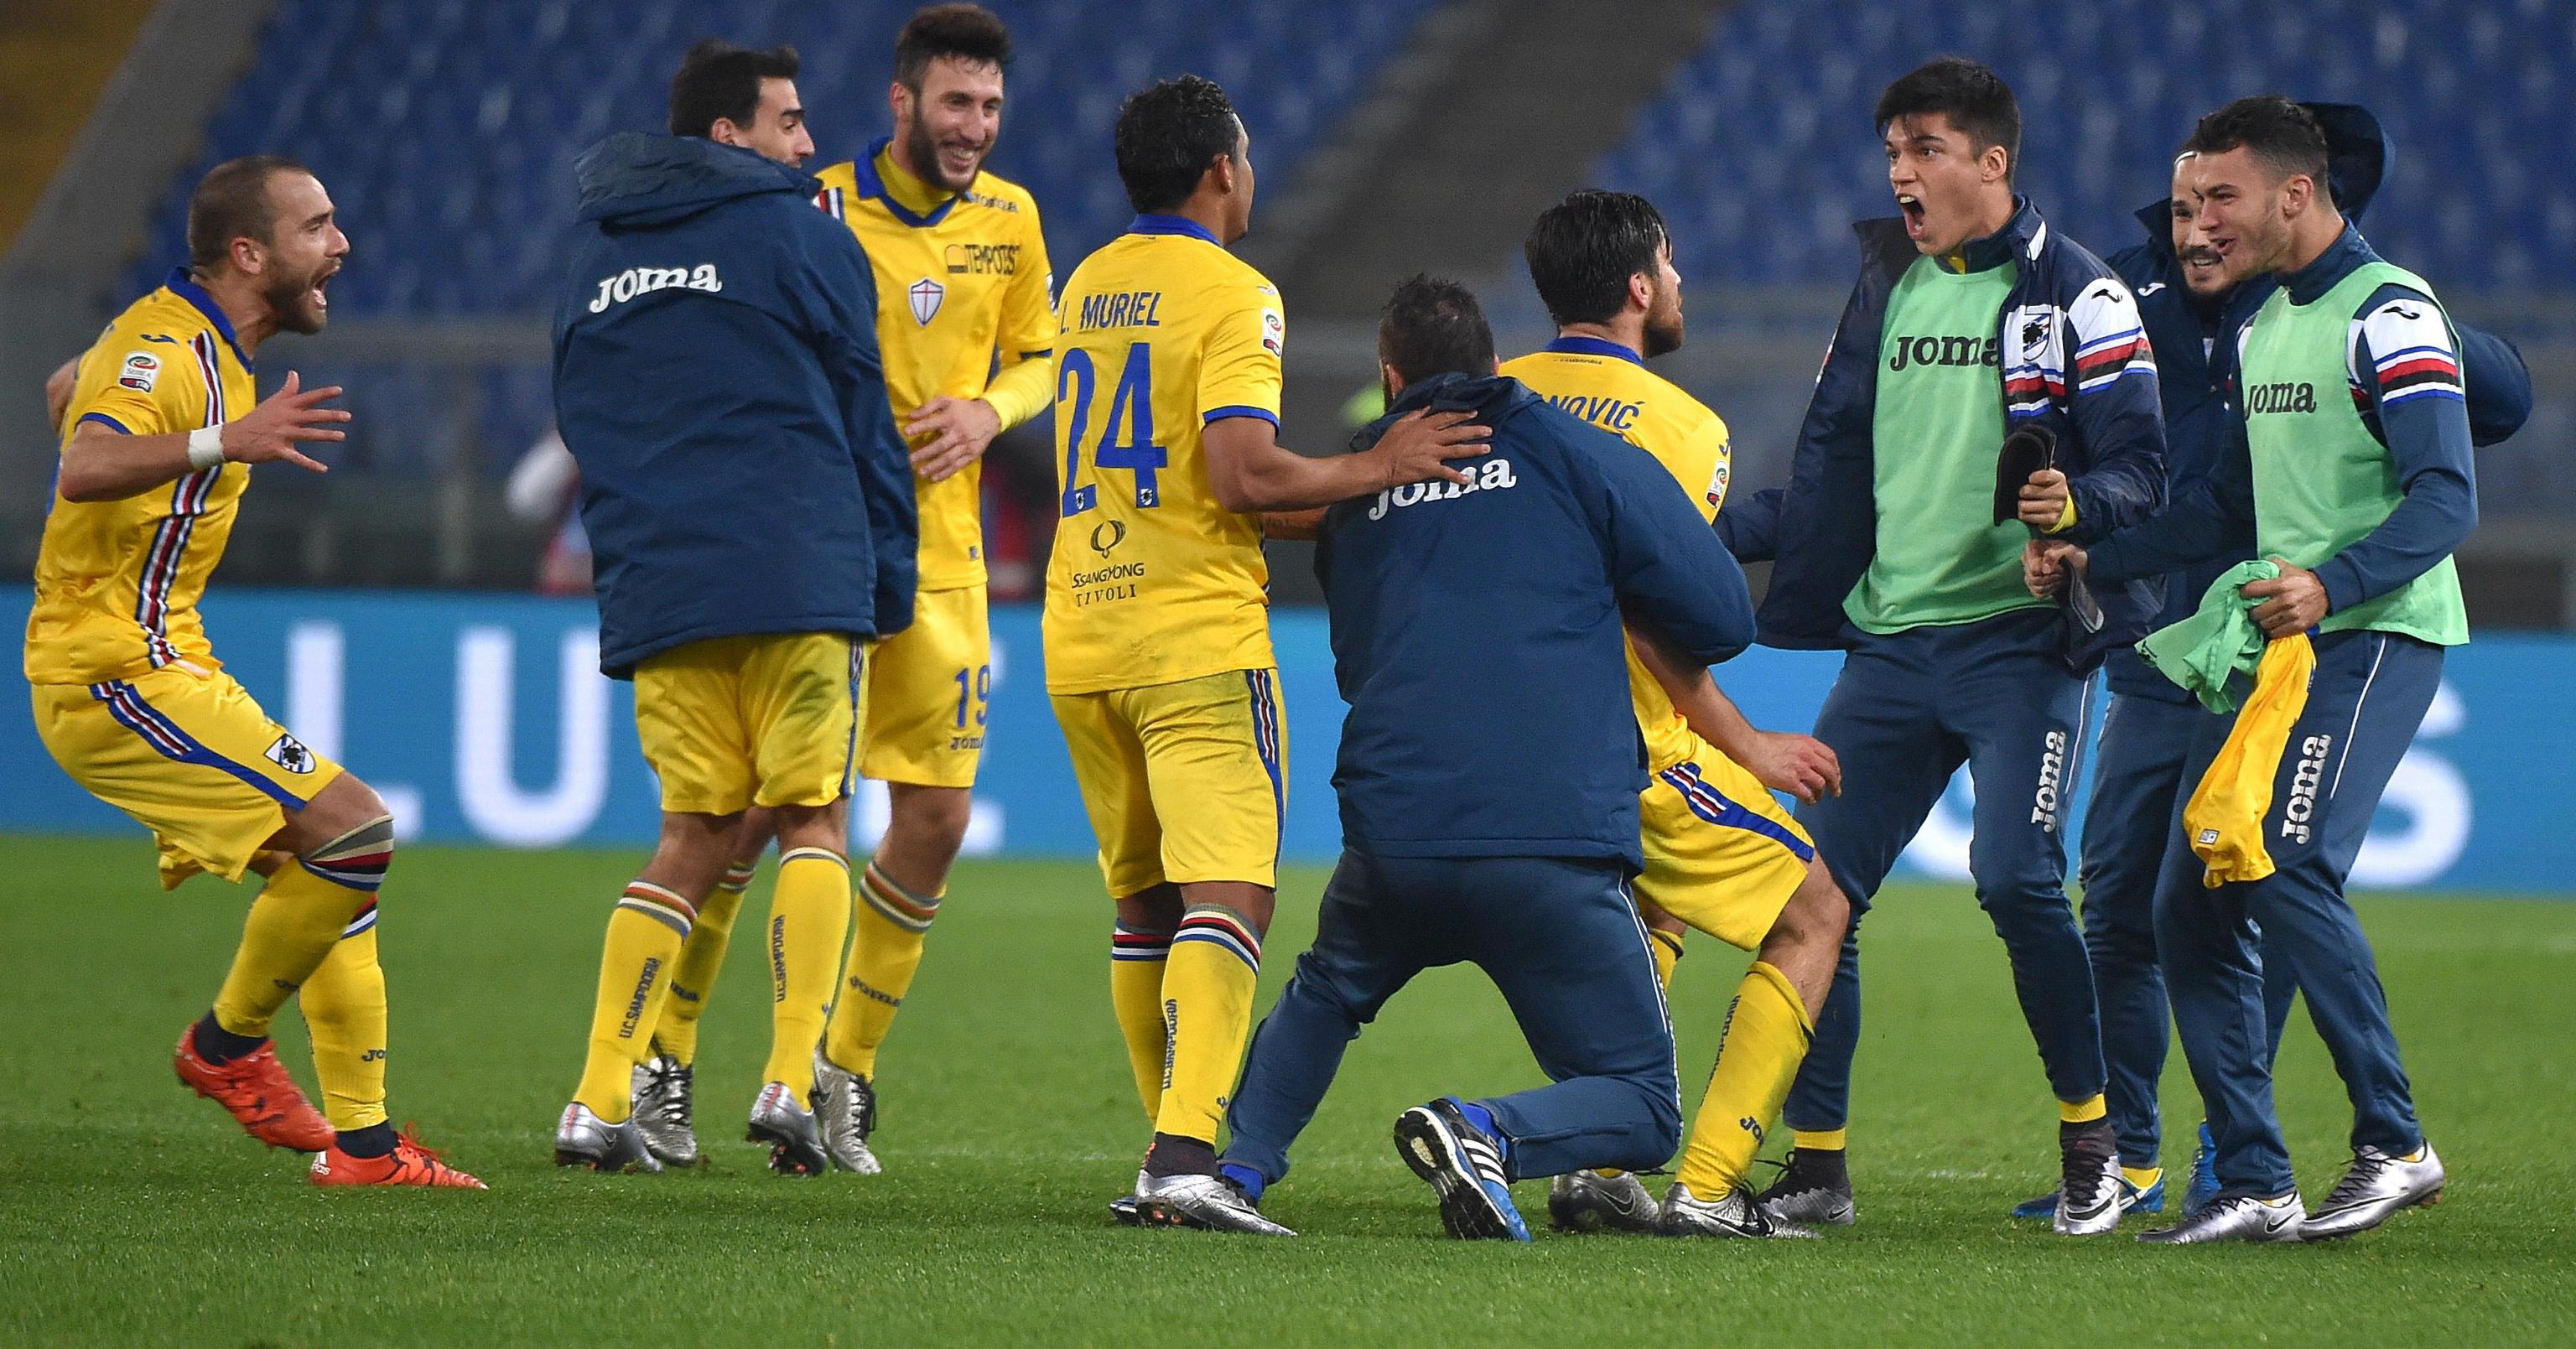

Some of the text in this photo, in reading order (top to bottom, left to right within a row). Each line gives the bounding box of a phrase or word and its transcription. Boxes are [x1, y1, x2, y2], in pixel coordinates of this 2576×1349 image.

[589, 264, 722, 314] Joma
[1080, 292, 1161, 330] MURIEL
[1057, 342, 1167, 517] 24
[1076, 584, 1136, 607] TIVOLI
[954, 665, 990, 728] 19
[951, 737, 982, 750] Jom
[2031, 731, 2065, 833] Joma
[2282, 734, 2331, 844] Joma
[1740, 1115, 1764, 1149] Jo
